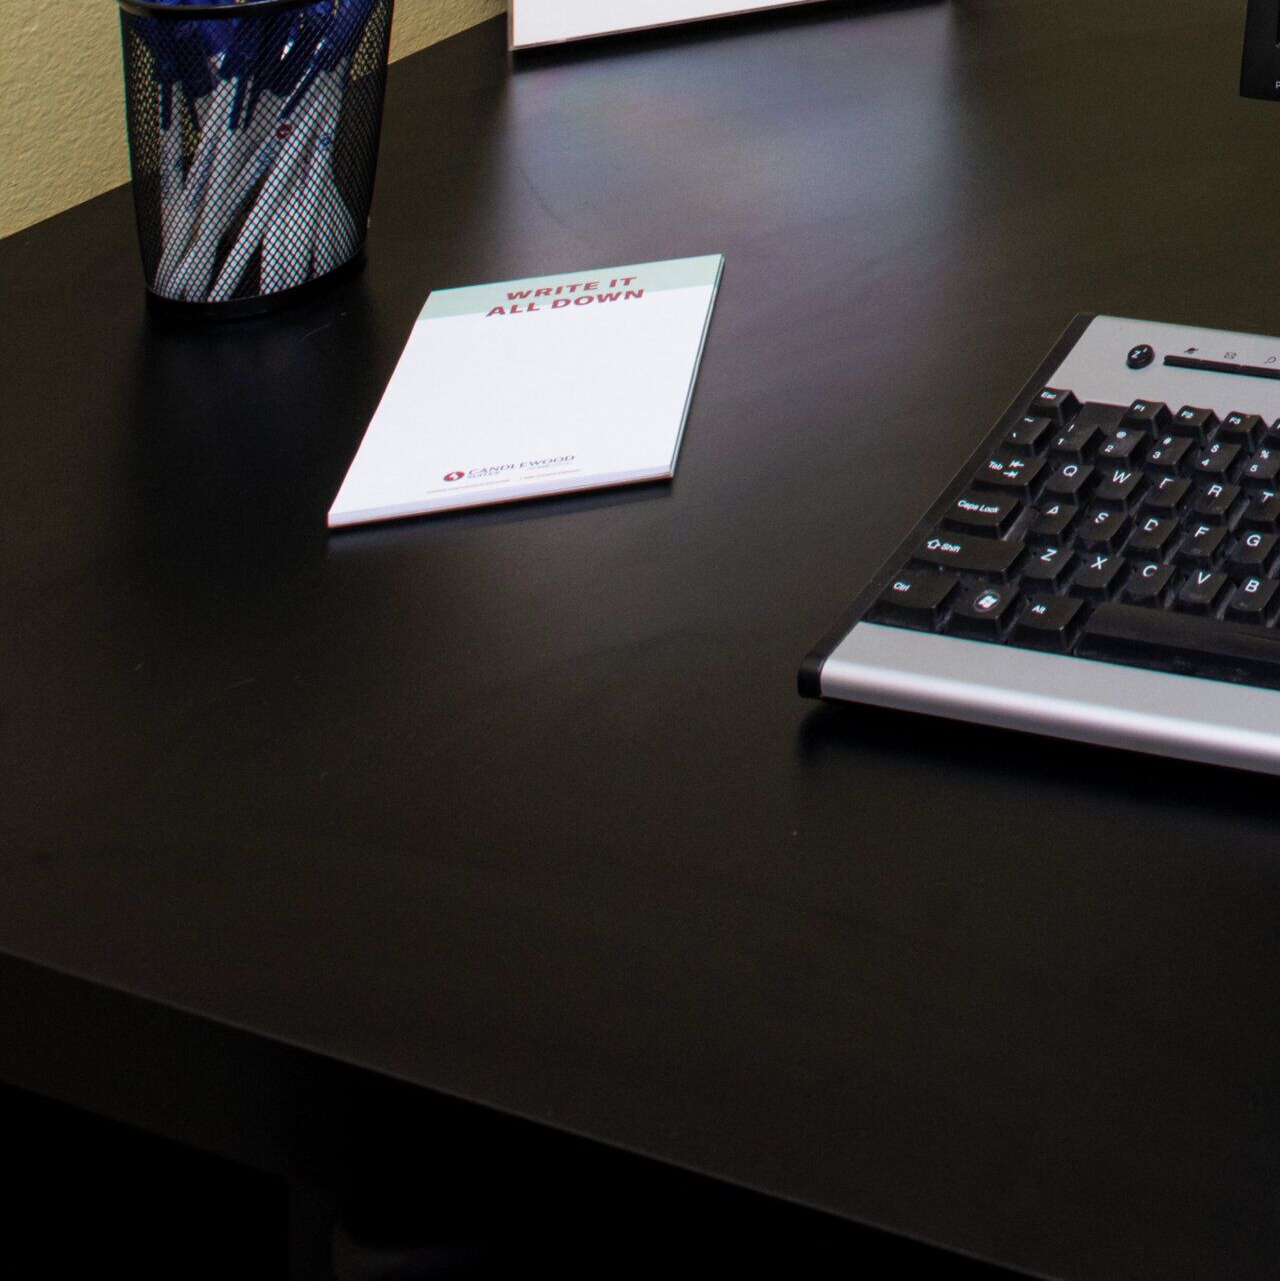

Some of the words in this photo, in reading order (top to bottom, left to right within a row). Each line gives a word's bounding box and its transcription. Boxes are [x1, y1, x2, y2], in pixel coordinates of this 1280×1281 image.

[506, 282, 600, 301] WRITE
[610, 276, 638, 288] IT
[485, 301, 541, 318] ALL
[551, 289, 645, 311] DOWN
